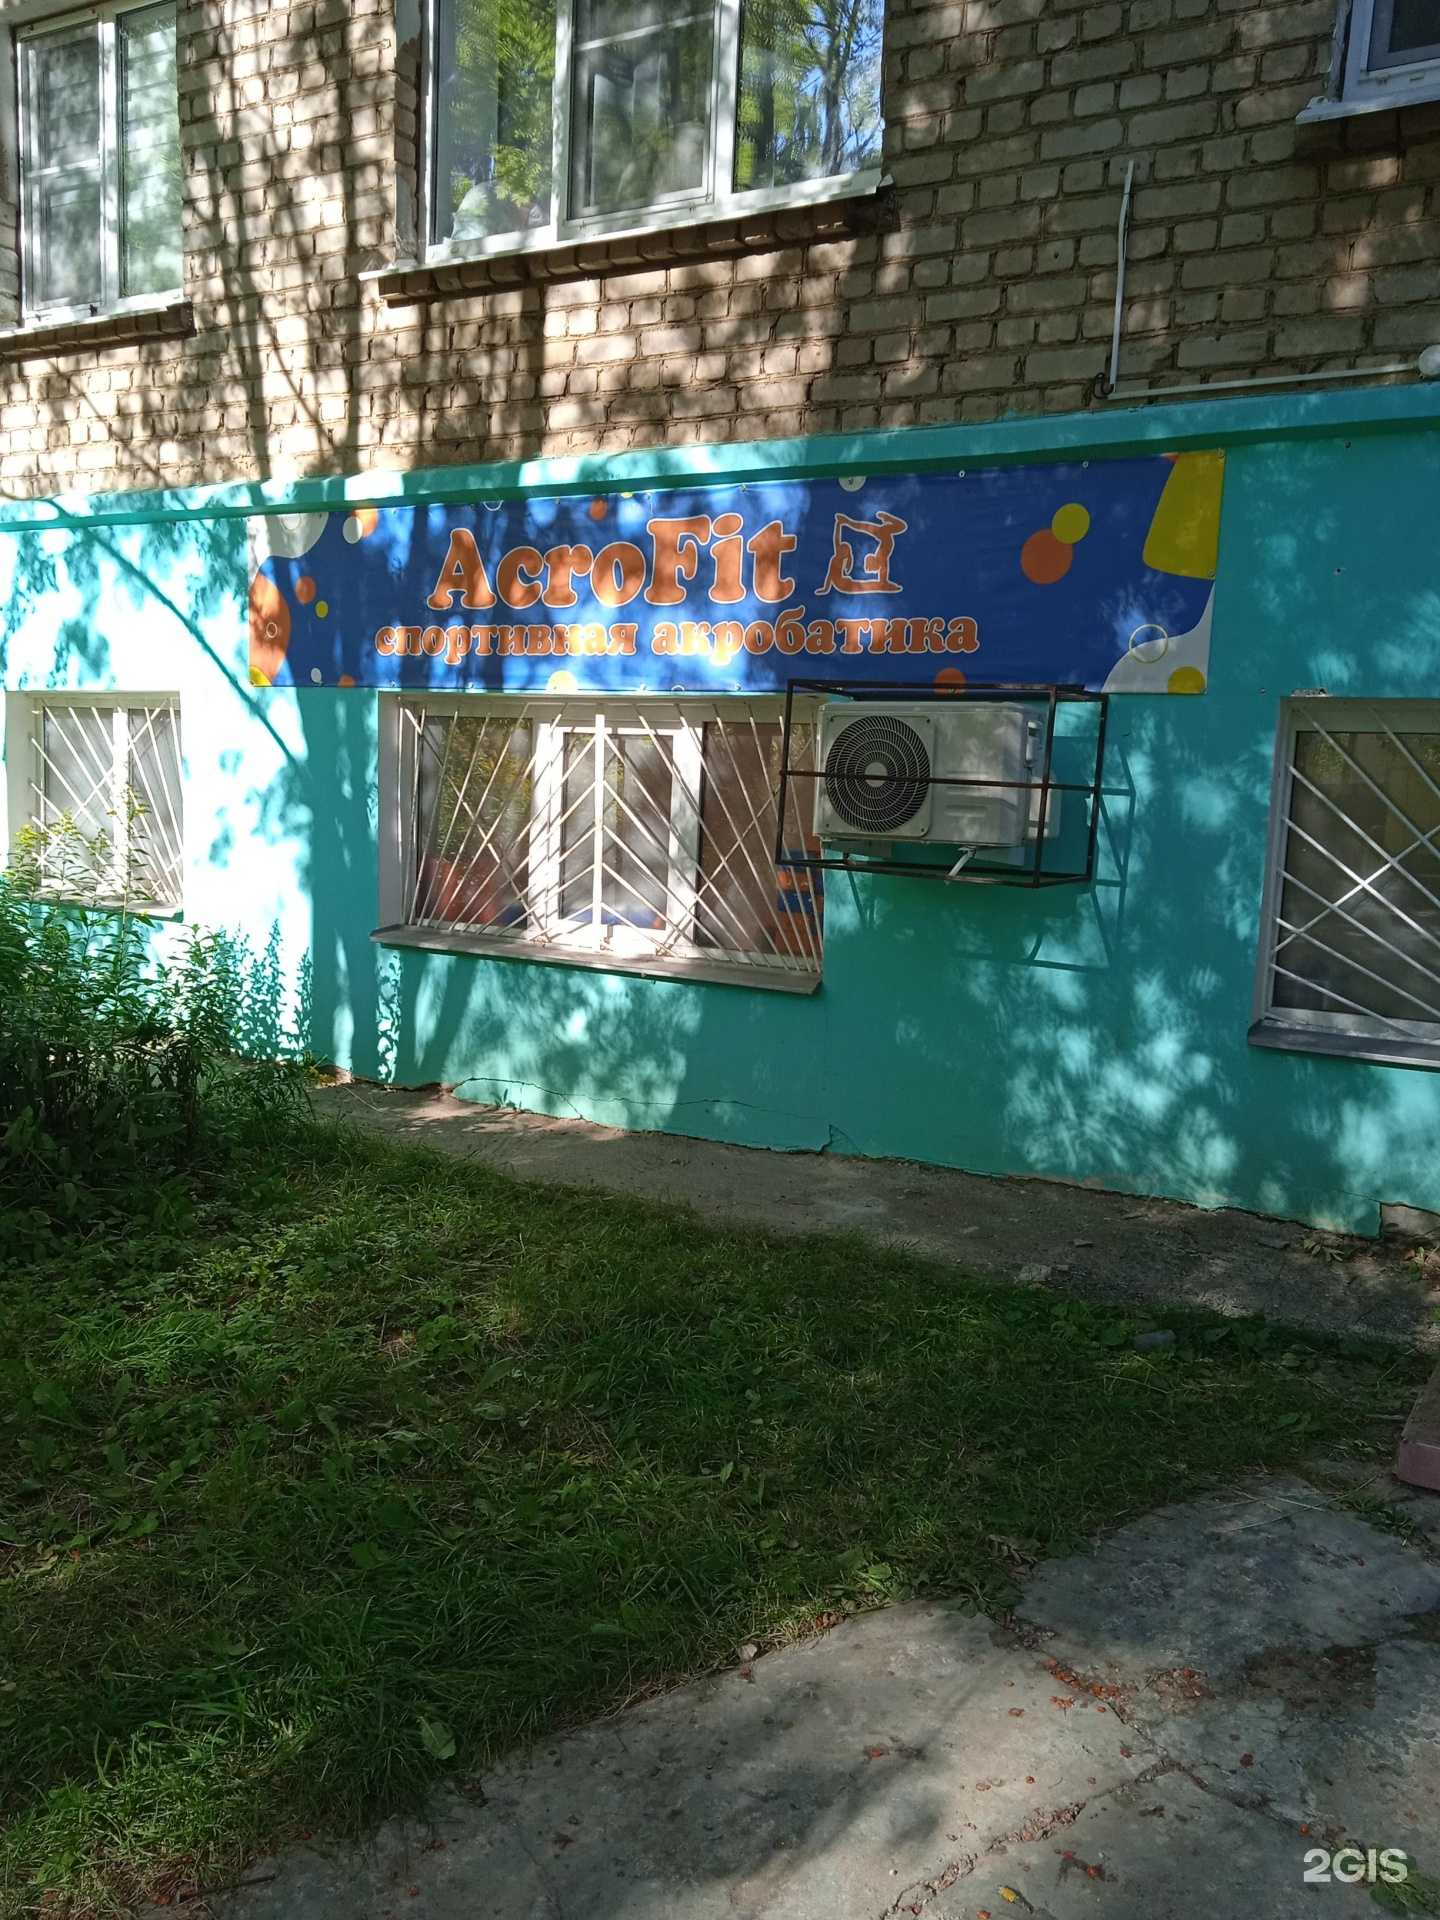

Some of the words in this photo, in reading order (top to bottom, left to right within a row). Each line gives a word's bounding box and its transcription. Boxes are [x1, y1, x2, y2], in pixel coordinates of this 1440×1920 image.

[427, 513, 797, 610] AcroFit
[375, 622, 638, 664] спортивная
[651, 605, 980, 665] акробатика
